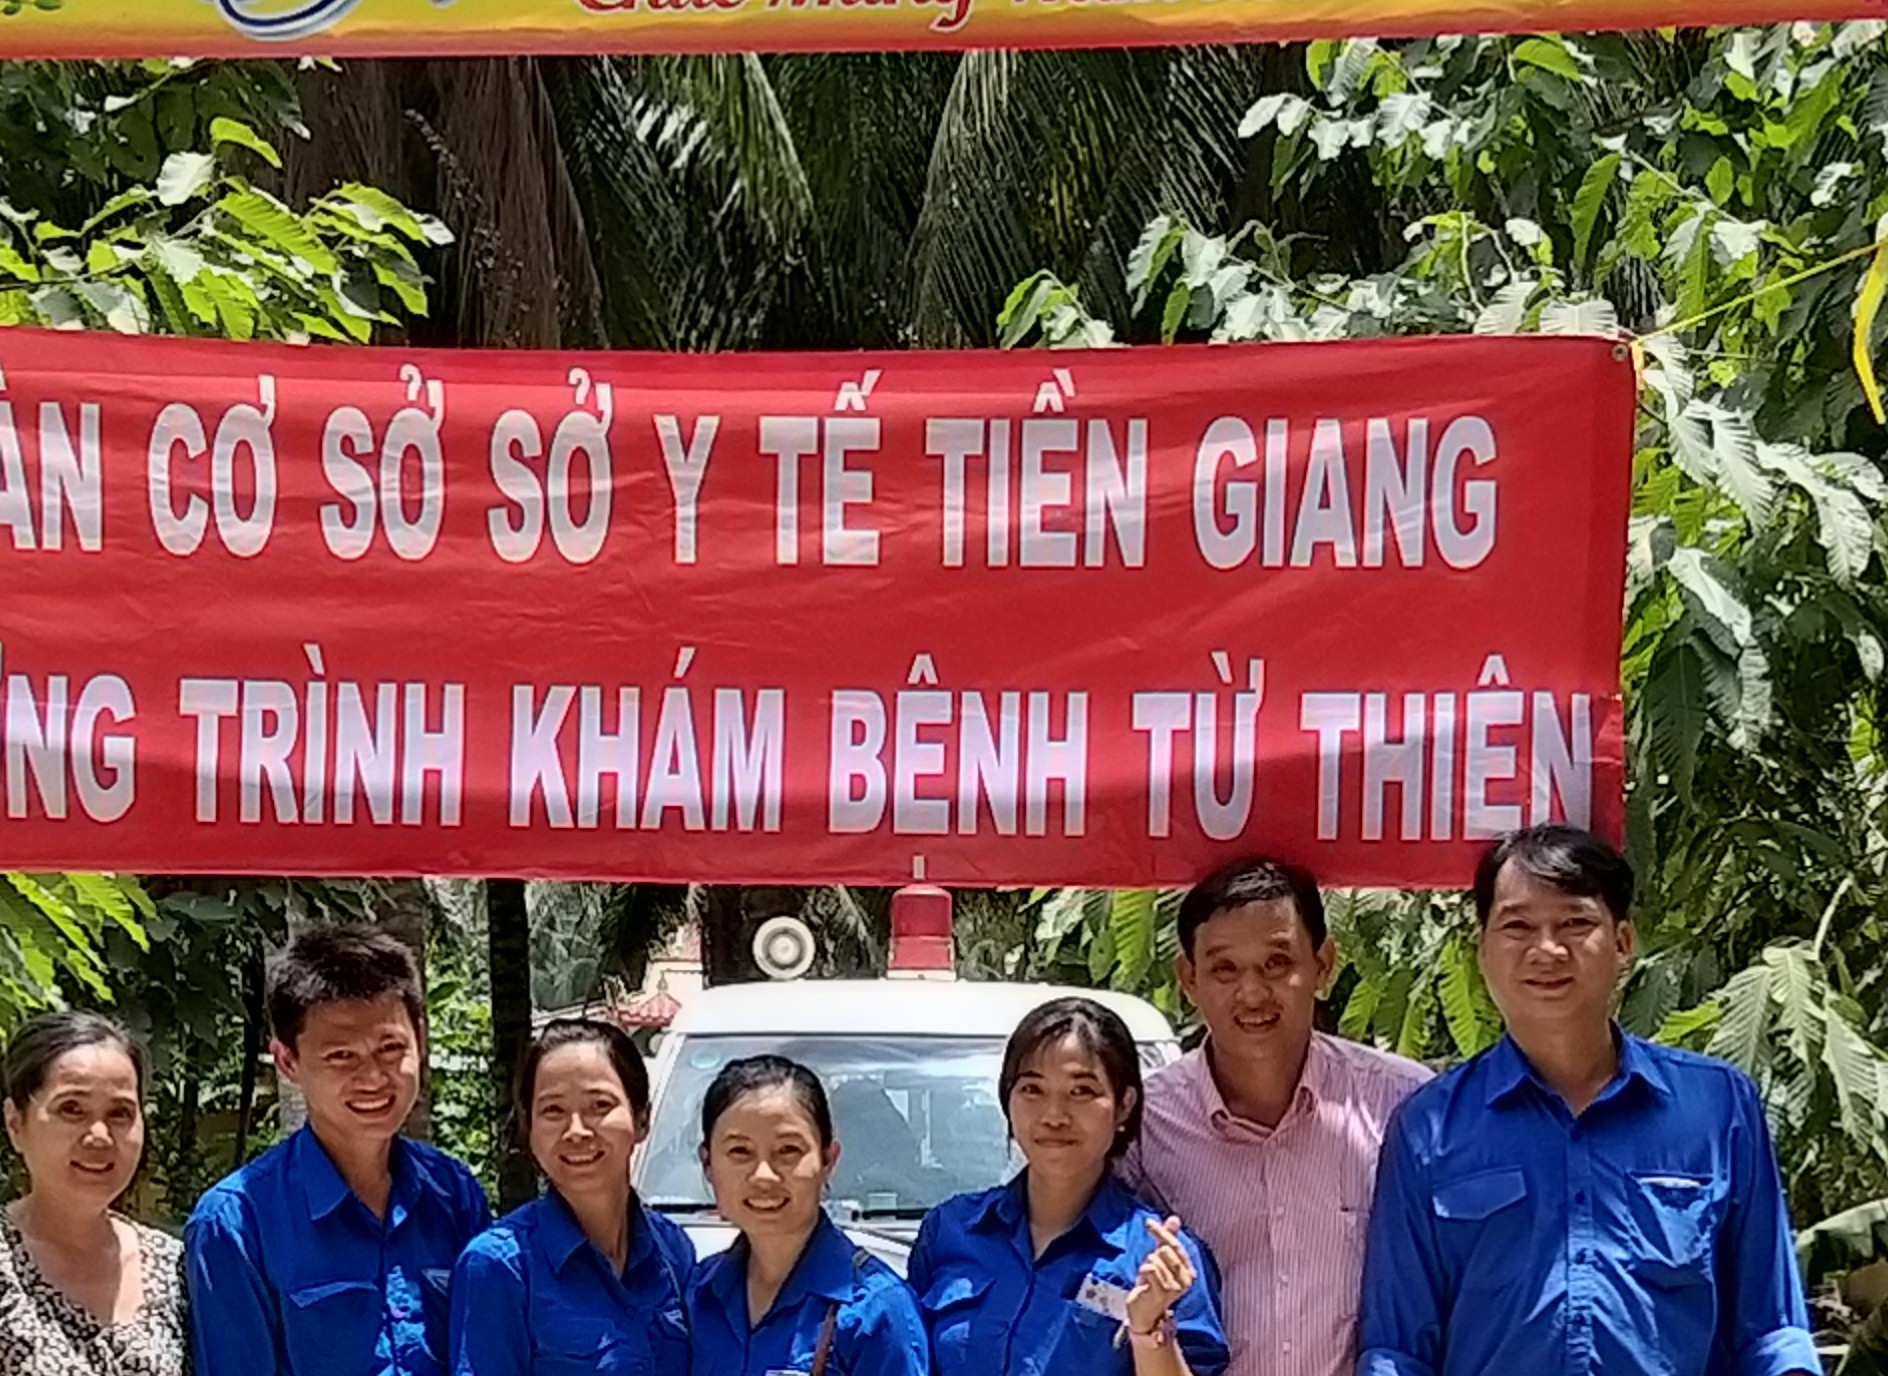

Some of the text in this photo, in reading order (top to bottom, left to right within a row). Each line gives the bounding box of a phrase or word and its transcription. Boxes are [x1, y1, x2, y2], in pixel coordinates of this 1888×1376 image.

[146, 373, 278, 558] CƠ
[319, 362, 446, 561] SỞ
[486, 366, 614, 564] SỞ
[652, 413, 721, 565] Y
[758, 369, 882, 566] TẾ
[924, 368, 1149, 568] TIỀN
[1192, 415, 1498, 570] GIANG
[178, 643, 466, 827] TRÌNH
[509, 646, 785, 832] KHÁM
[828, 653, 1089, 881] BỆNH
[1131, 650, 1266, 841] TỪ
